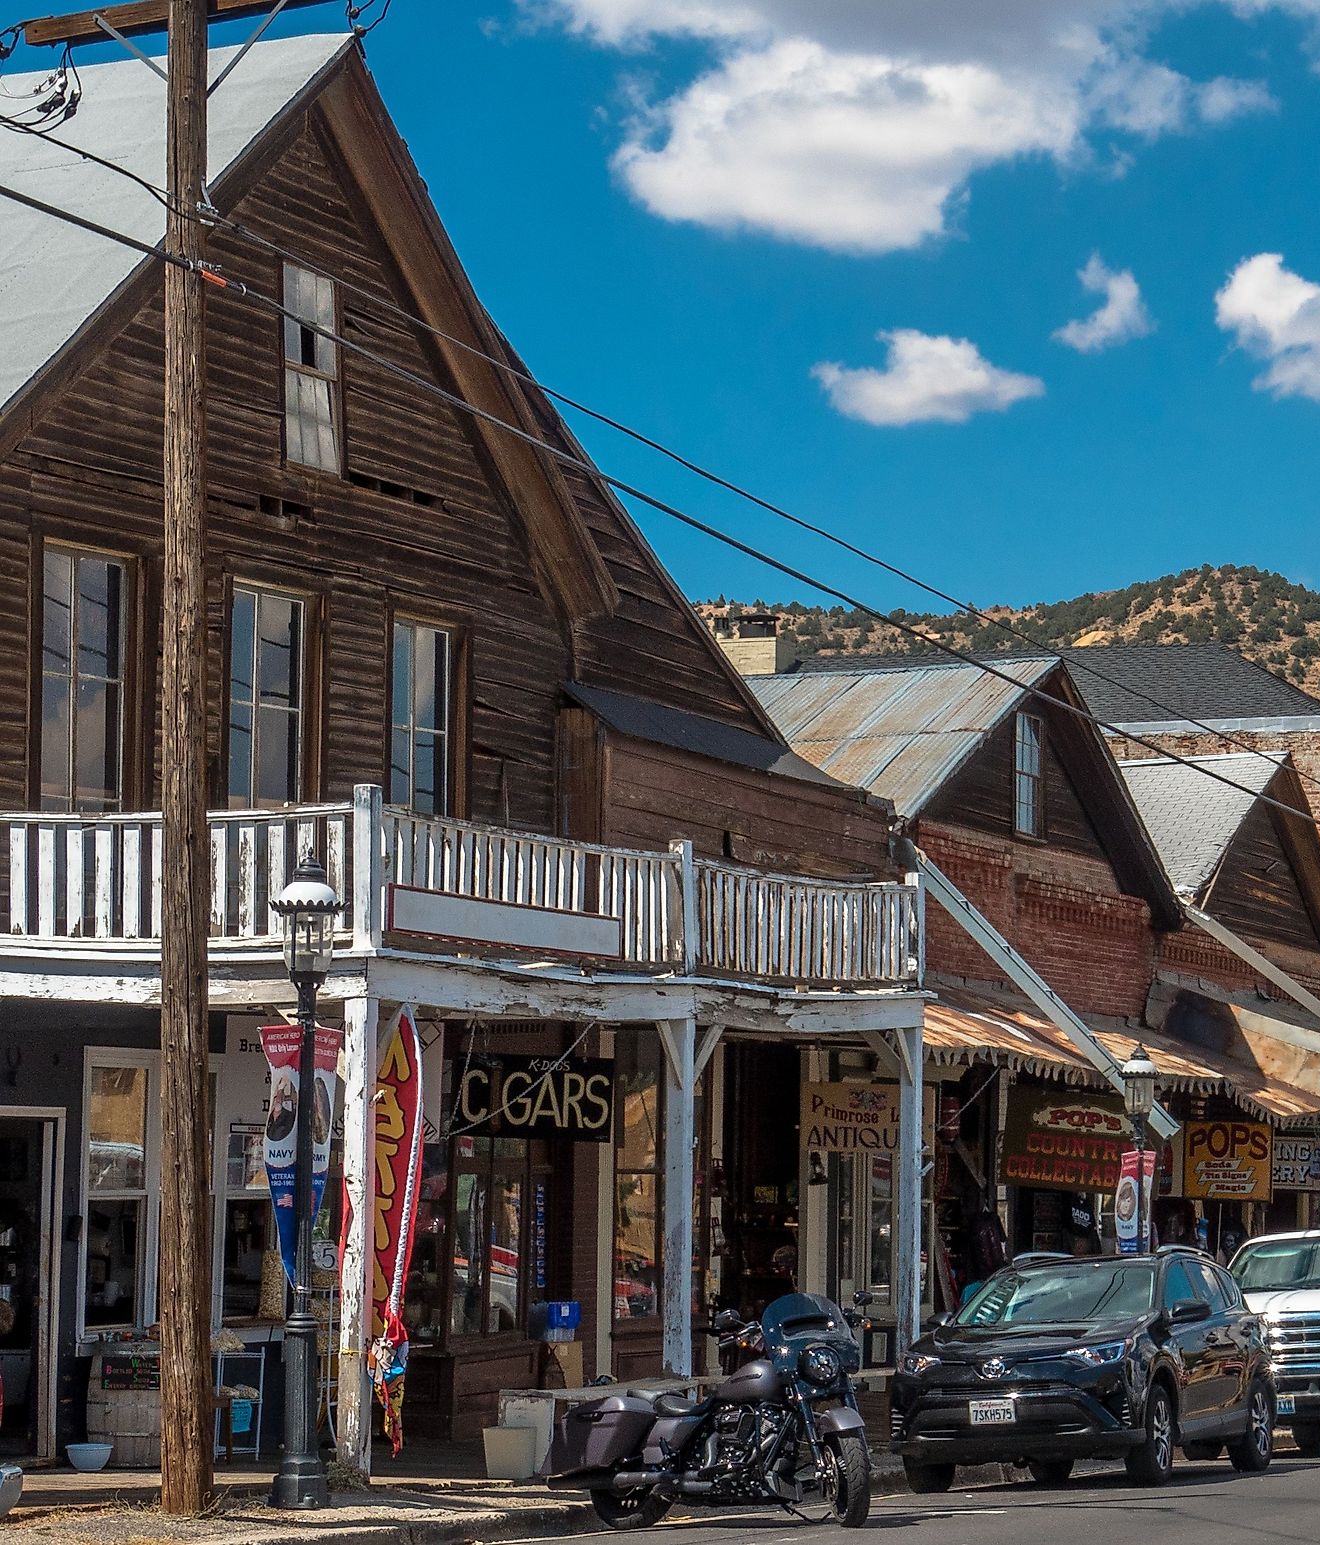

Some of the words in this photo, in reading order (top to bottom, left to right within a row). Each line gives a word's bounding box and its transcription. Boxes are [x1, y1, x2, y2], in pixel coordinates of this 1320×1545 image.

[812, 1094, 880, 1124] Primrose
[1048, 1109, 1122, 1131] POP'S
[807, 1125, 900, 1149] ANTIQU
[1189, 1124, 1268, 1160] POPS
[269, 1149, 294, 1159] NAVY
[312, 1153, 326, 1162] RMY
[1275, 1142, 1310, 1160] ING
[1007, 1156, 1121, 1188] COLLECTAB
[1222, 1173, 1247, 1181] Signs
[1273, 1165, 1310, 1183] ERY
[1215, 1185, 1246, 1193] Magic
[973, 1408, 1013, 1422] 7SKH575
